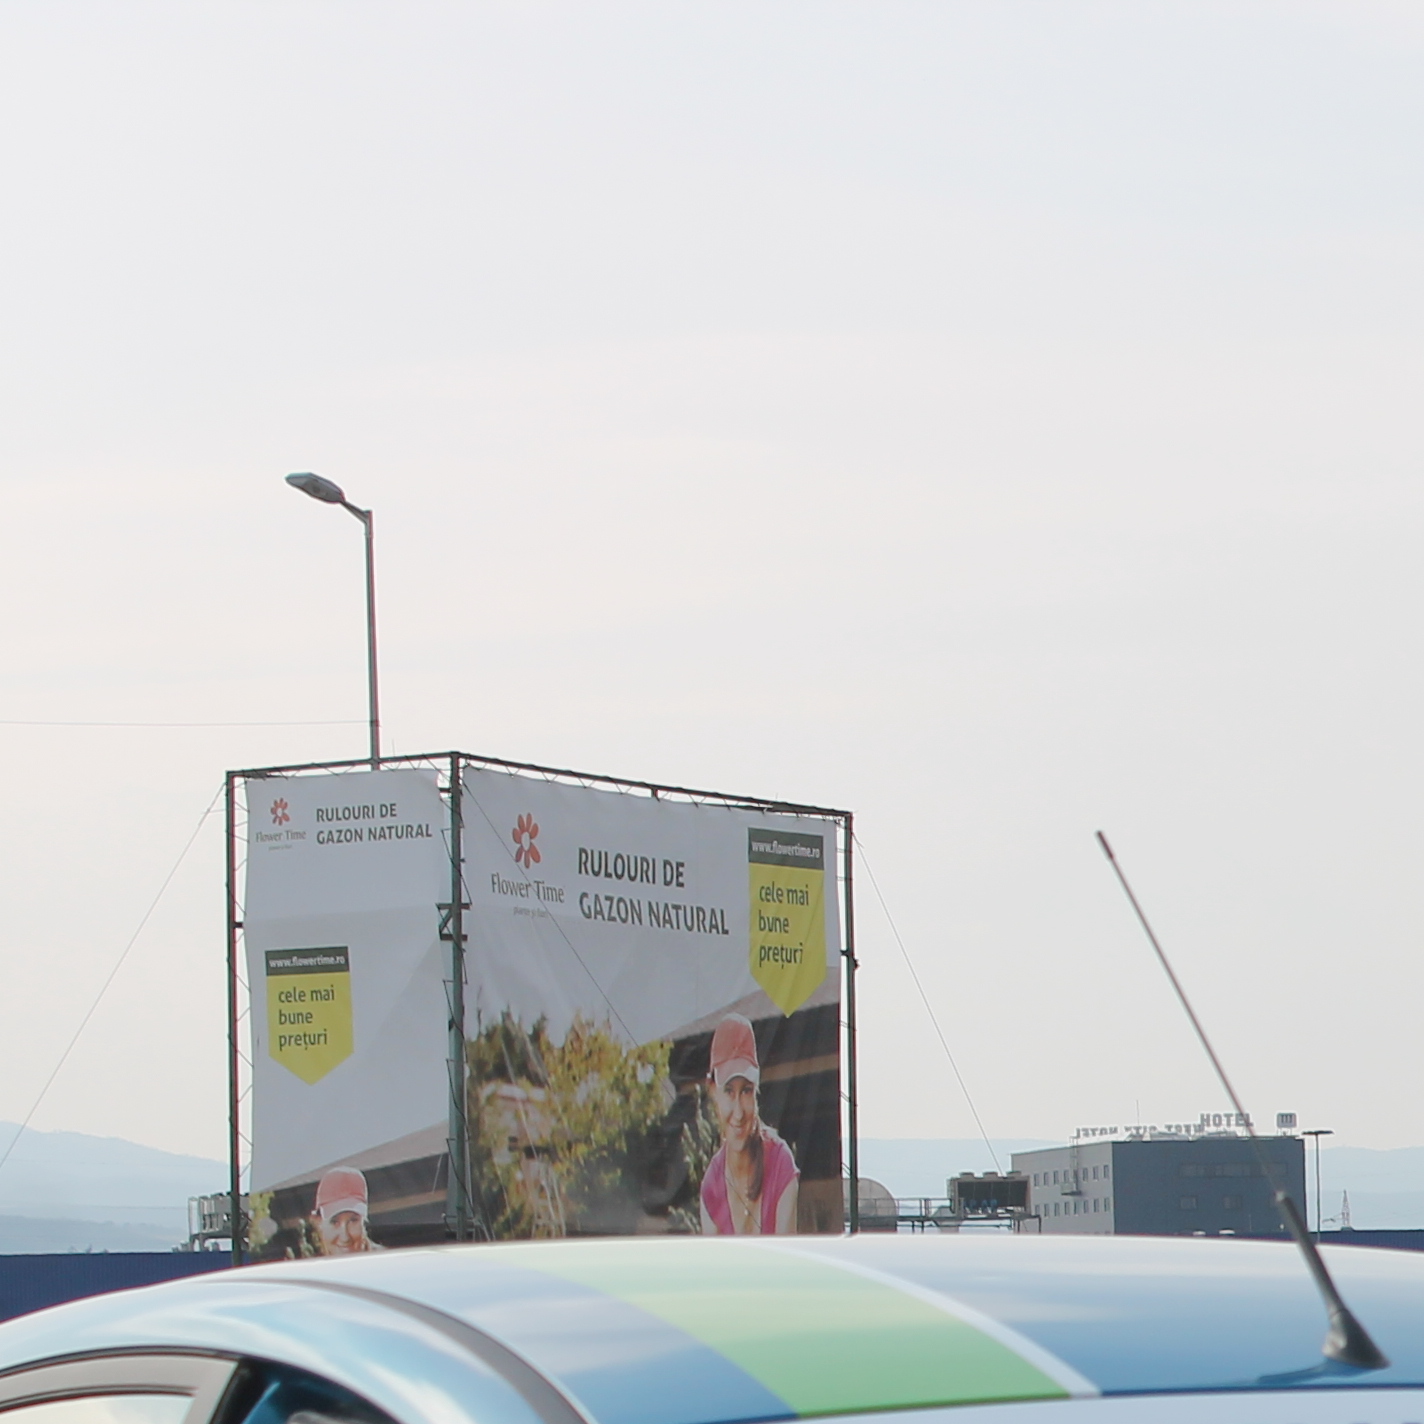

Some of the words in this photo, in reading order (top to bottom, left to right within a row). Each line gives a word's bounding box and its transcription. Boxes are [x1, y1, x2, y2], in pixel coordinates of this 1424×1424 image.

[316, 805, 375, 823] RULOURI
[379, 803, 398, 818] DE
[255, 831, 282, 843] Flower
[285, 829, 307, 841] Time
[316, 827, 364, 845] GAZON
[367, 823, 433, 842] NATURAL
[751, 840, 821, 858] www.flowertime.ro
[577, 847, 656, 885] RULOURI
[662, 859, 685, 888] DE
[490, 872, 530, 899] Flower
[533, 879, 565, 903] Time
[759, 881, 784, 904] cele
[786, 884, 809, 906] mai
[579, 892, 643, 926] GAZON
[648, 900, 730, 936] NATURAL
[758, 909, 790, 934] bune
[268, 954, 346, 968] www.flowertime.ro
[758, 942, 803, 969] prețuri
[278, 986, 307, 1003] cele
[310, 984, 335, 1001] mai
[278, 1009, 314, 1025] bune
[278, 1028, 328, 1052] prețuri
[1200, 1113, 1254, 1127] HOTEL
